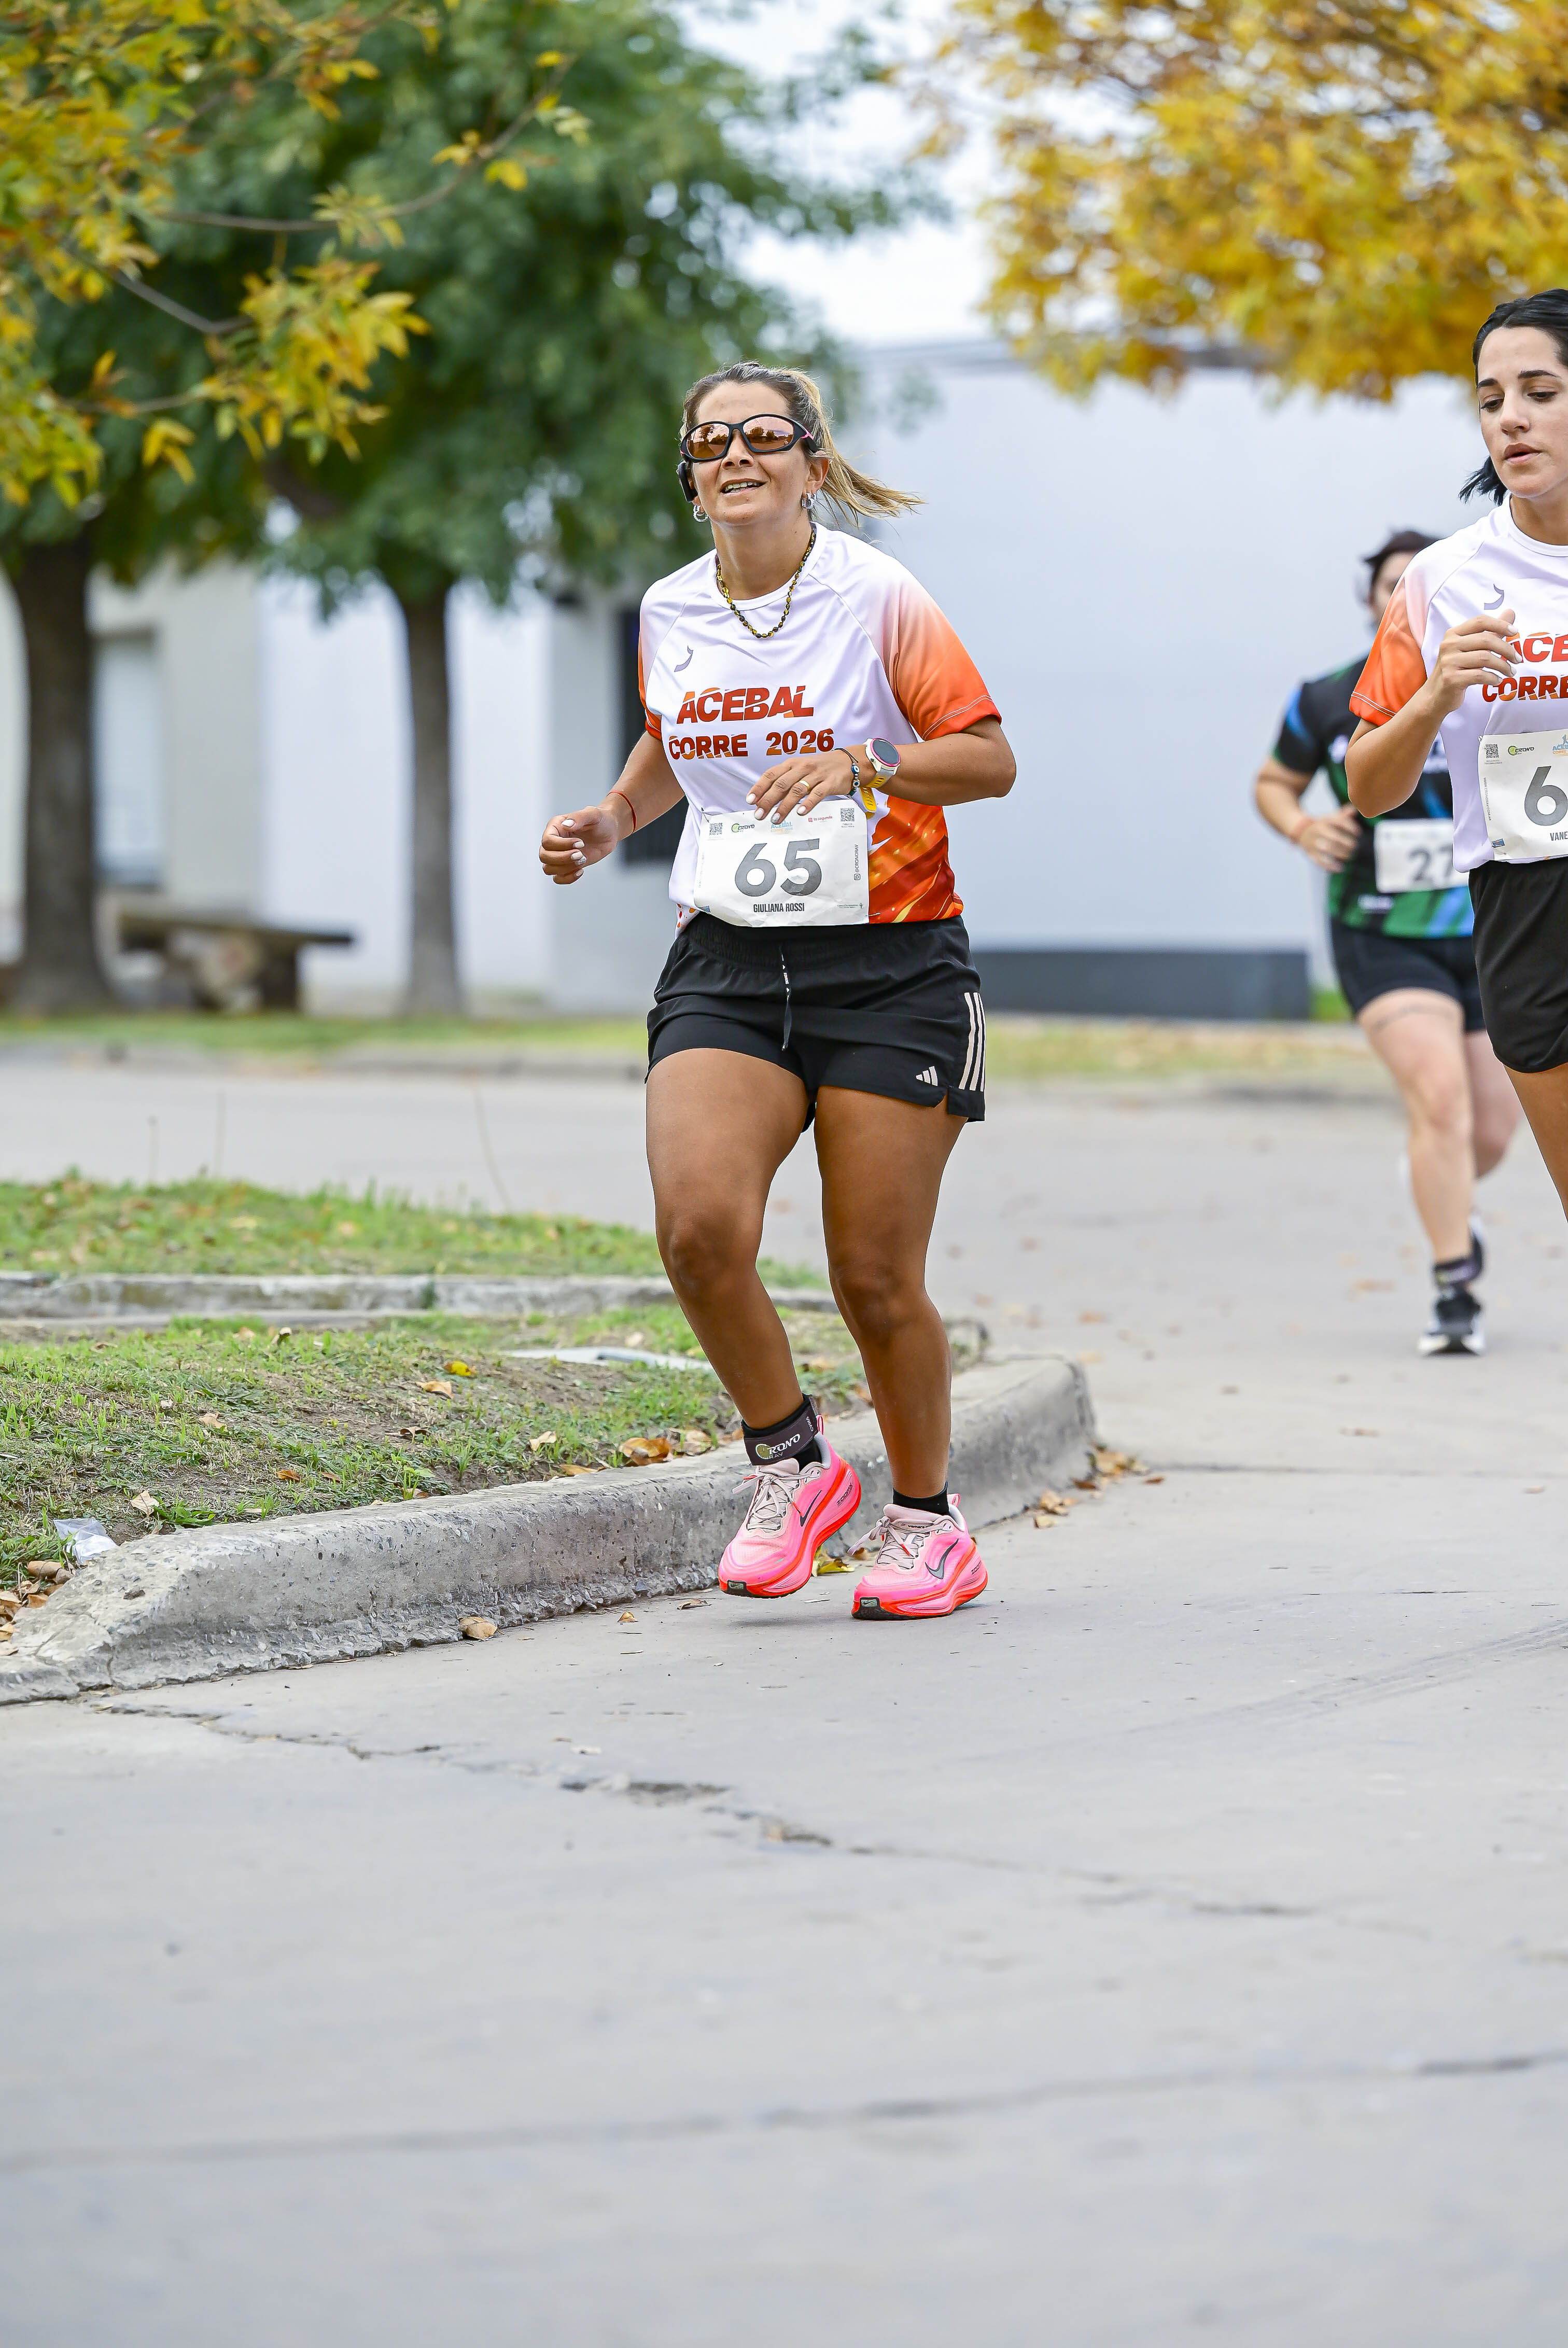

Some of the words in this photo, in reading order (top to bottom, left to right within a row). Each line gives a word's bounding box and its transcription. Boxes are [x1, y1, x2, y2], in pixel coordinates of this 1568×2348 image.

[676, 685, 814, 724] ACEBAL
[669, 733, 748, 760] CORRE
[766, 728, 834, 756] 2026
[1524, 766, 1568, 826] 6
[1550, 831, 1568, 841] VANE
[735, 838, 822, 897] 65
[753, 903, 783, 913] GIULIANA
[786, 903, 805, 912] ROSSI
